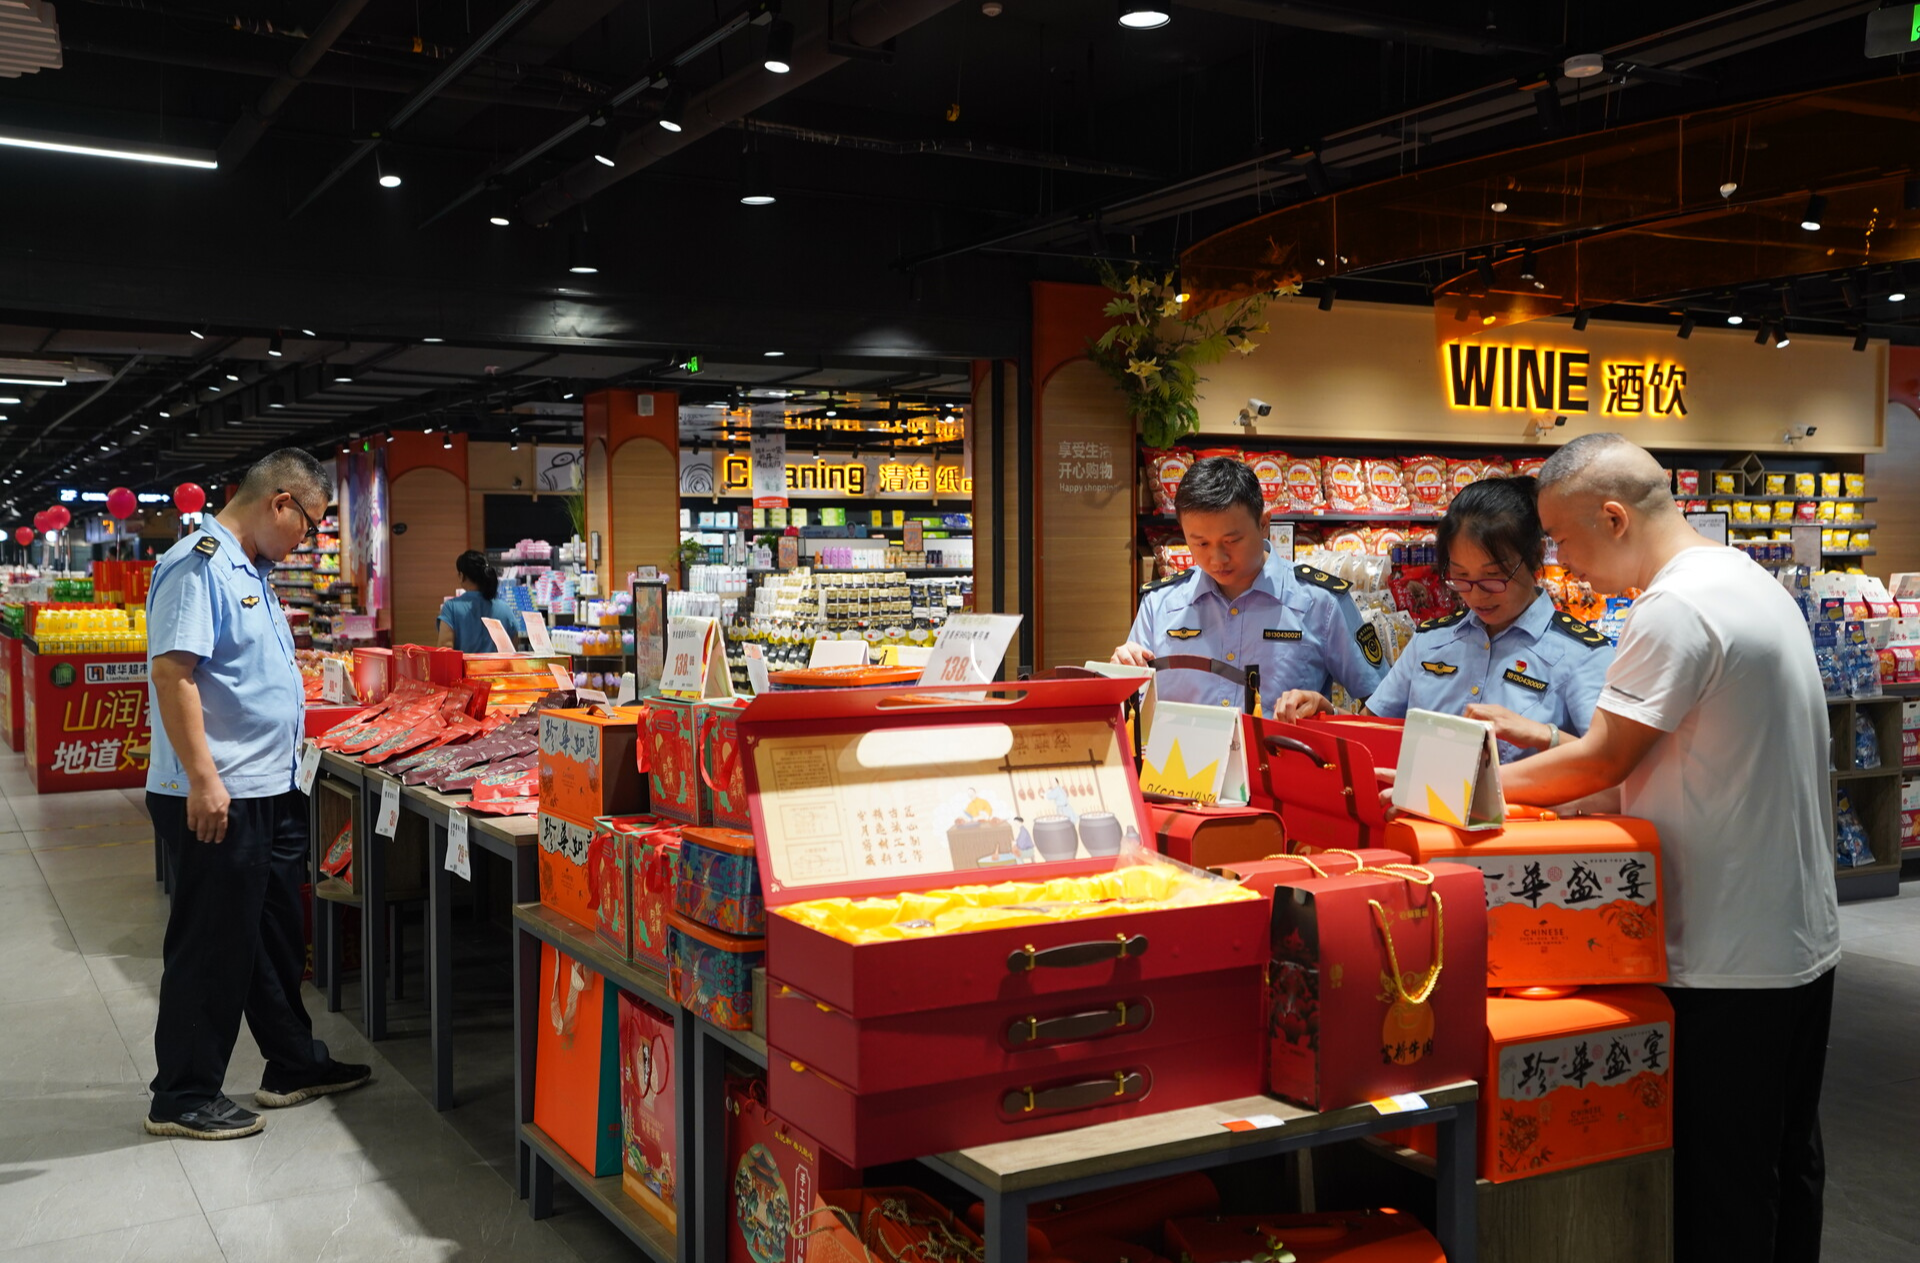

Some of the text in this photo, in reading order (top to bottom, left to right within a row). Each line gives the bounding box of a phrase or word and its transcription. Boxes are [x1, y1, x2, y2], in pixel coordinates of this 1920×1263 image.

[1448, 343, 1590, 412] WINE
[1605, 362, 1688, 416] 酒饮
[724, 457, 865, 495] Caning
[1058, 461, 1113, 479] 开心购物
[1059, 483, 1083, 493] Happy
[1264, 629, 1301, 639] 18130430021
[1523, 928, 1564, 937] CHINESE
